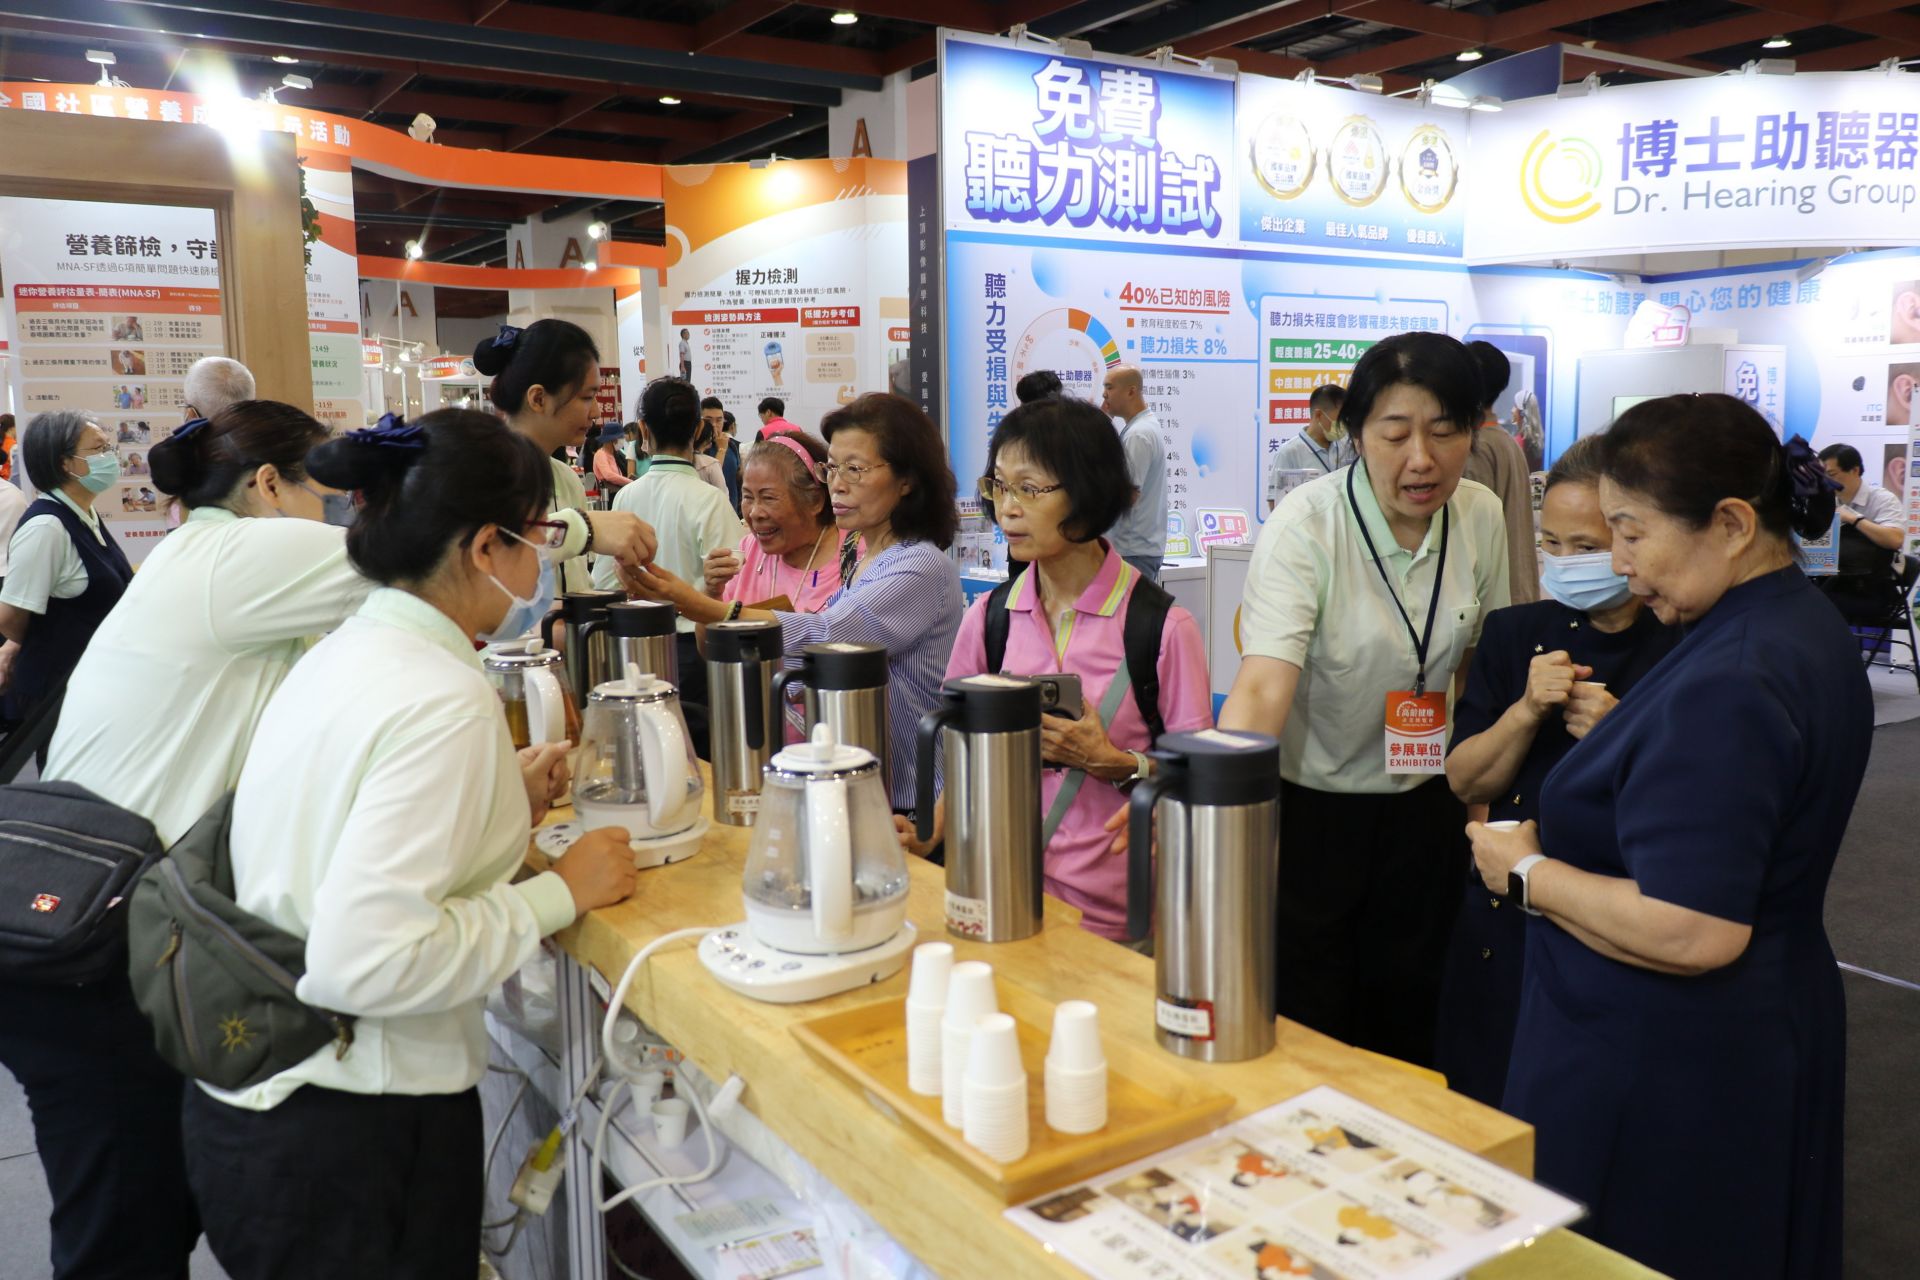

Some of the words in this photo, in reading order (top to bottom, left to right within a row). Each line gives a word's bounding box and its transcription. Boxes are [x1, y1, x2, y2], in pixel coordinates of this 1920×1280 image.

[1032, 59, 1160, 150] 免費
[1616, 110, 1919, 181] 博士助聽器
[965, 131, 1222, 237] 聽力測試
[1613, 185, 1667, 215] Dr.
[1683, 179, 1816, 214] Hearing
[1827, 174, 1917, 213] Group
[1260, 215, 1306, 234] 傑出企業
[1325, 220, 1389, 241] 最佳人氣品牌
[1406, 228, 1447, 246] 優良商人
[735, 267, 799, 285] 握力檢測
[1119, 281, 1231, 308] 40%已知的風險
[1189, 320, 1203, 330] 7%
[893, 331, 911, 339] 行動
[1140, 335, 1198, 355] 聽力損失
[1203, 338, 1227, 356] 8%
[984, 272, 1008, 452] 聽力受損與失
[1054, 370, 1092, 382] 士助聽器
[1182, 369, 1195, 379] 3%
[1167, 386, 1180, 396] 2%
[1160, 402, 1172, 412] 1%
[1167, 419, 1179, 429] 1%
[1166, 451, 1180, 461] 4%
[1174, 467, 1188, 477] 4%
[1174, 484, 1187, 494] 2%
[1174, 500, 1187, 510] 2%
[1389, 743, 1442, 757] 參展單位
[1389, 758, 1442, 767] EXHIBITOR
